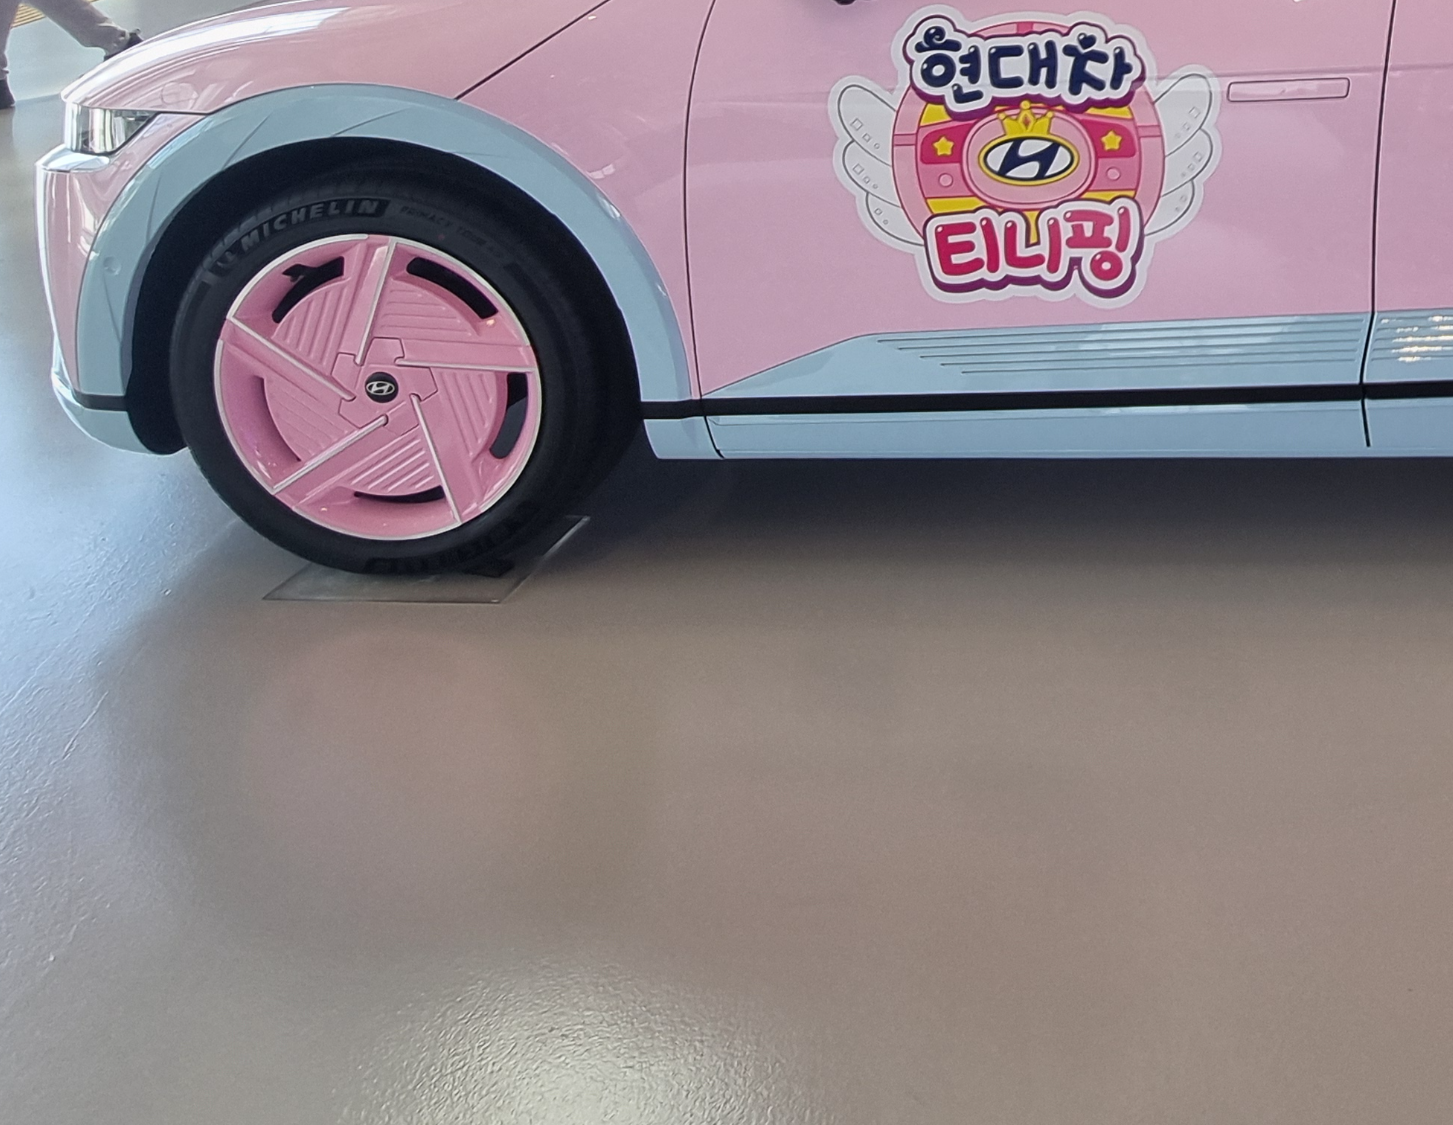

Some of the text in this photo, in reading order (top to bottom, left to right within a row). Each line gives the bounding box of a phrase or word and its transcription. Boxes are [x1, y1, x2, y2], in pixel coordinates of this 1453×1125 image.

[915, 26, 1134, 104] 현대차
[242, 198, 379, 252] MICHELIN
[934, 207, 1131, 281] 티니핑
